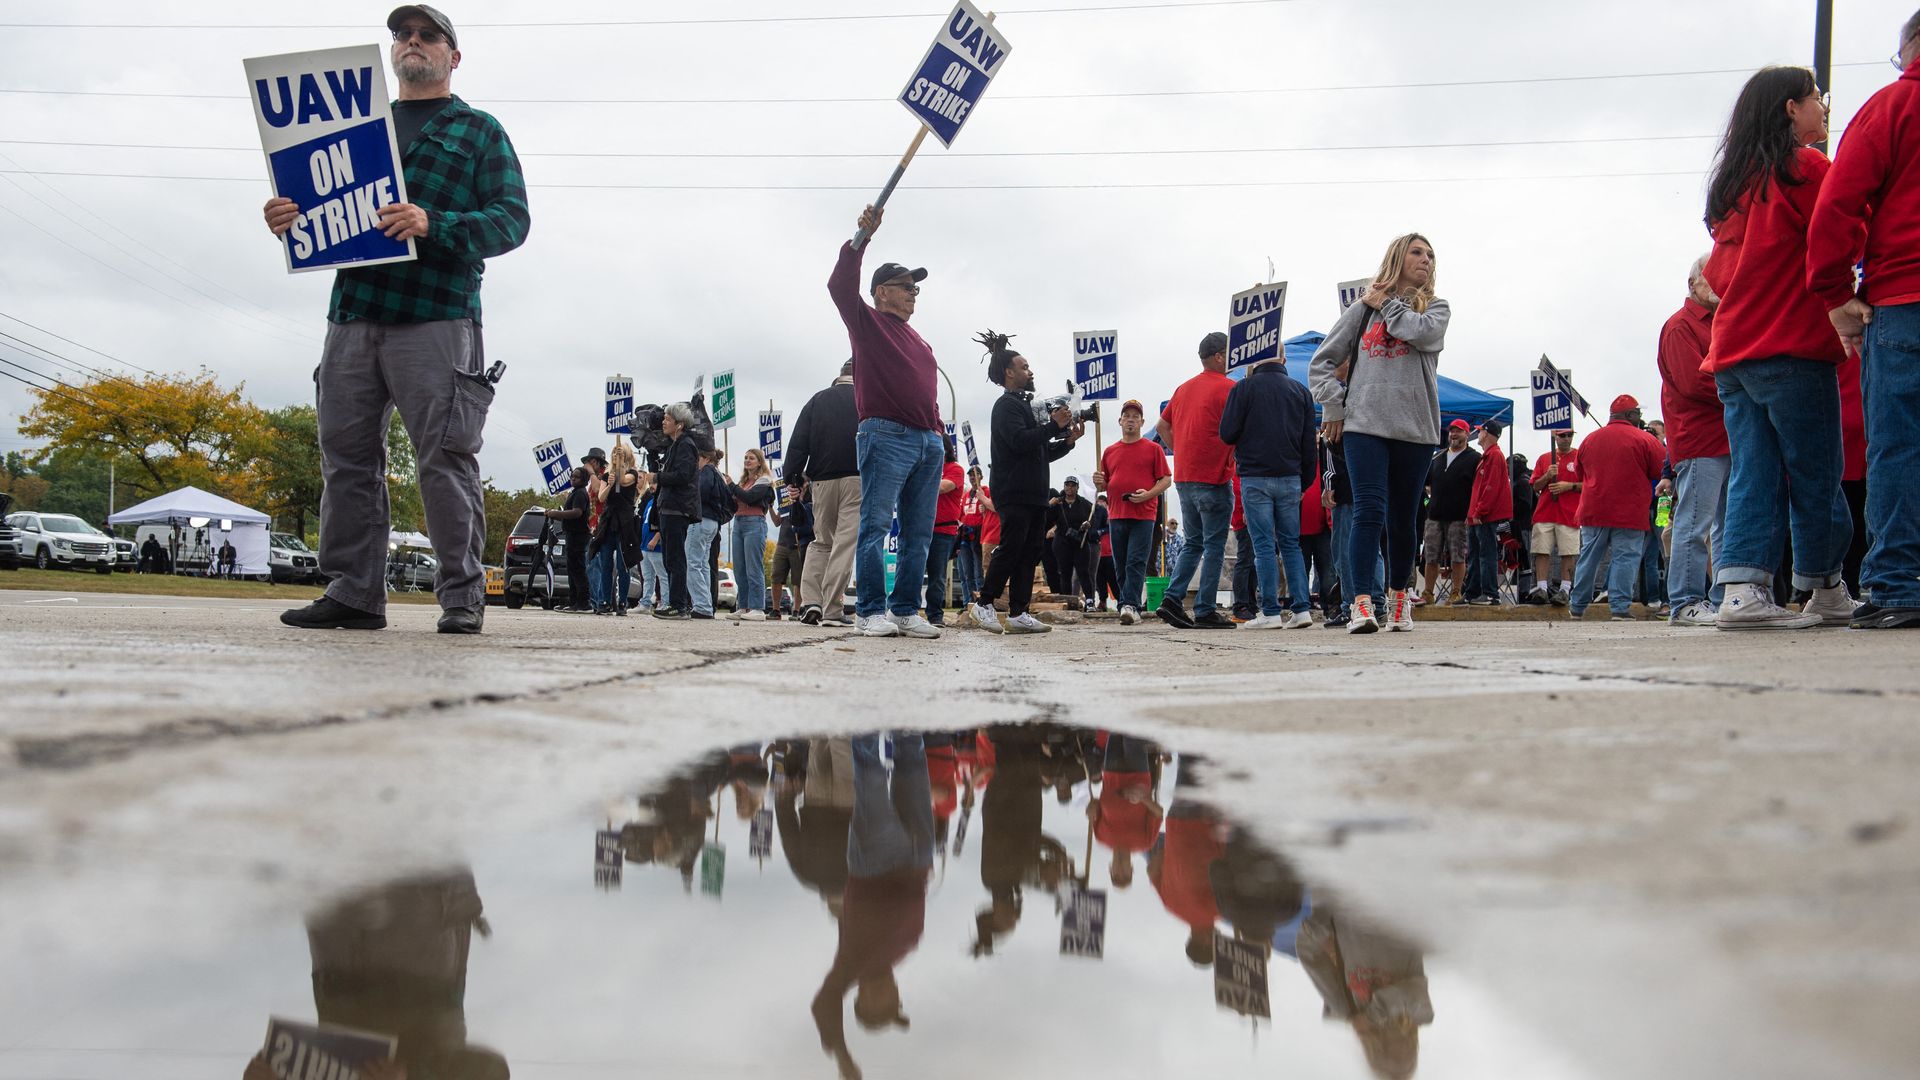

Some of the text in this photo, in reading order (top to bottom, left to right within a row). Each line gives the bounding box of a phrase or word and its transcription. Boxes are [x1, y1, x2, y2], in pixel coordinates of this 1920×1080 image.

[949, 8, 1004, 72] UAW
[941, 61, 972, 91] ON
[255, 66, 372, 128] UAW
[908, 77, 971, 124] STRIKE
[309, 138, 355, 197] ON
[1233, 289, 1282, 317] UAW
[1246, 317, 1265, 340] ON
[1076, 336, 1115, 354] UAW
[1230, 328, 1277, 366] STRIKE
[1088, 359, 1103, 377] ON
[607, 382, 631, 395] UAW
[713, 373, 733, 389] UAW
[614, 401, 624, 415] ON
[719, 390, 728, 406] ON
[1545, 395, 1559, 411] ON
[760, 414, 781, 426] UAW
[1535, 406, 1569, 428] STRIKE
[535, 442, 563, 462] UAW
[551, 460, 564, 476] ON
